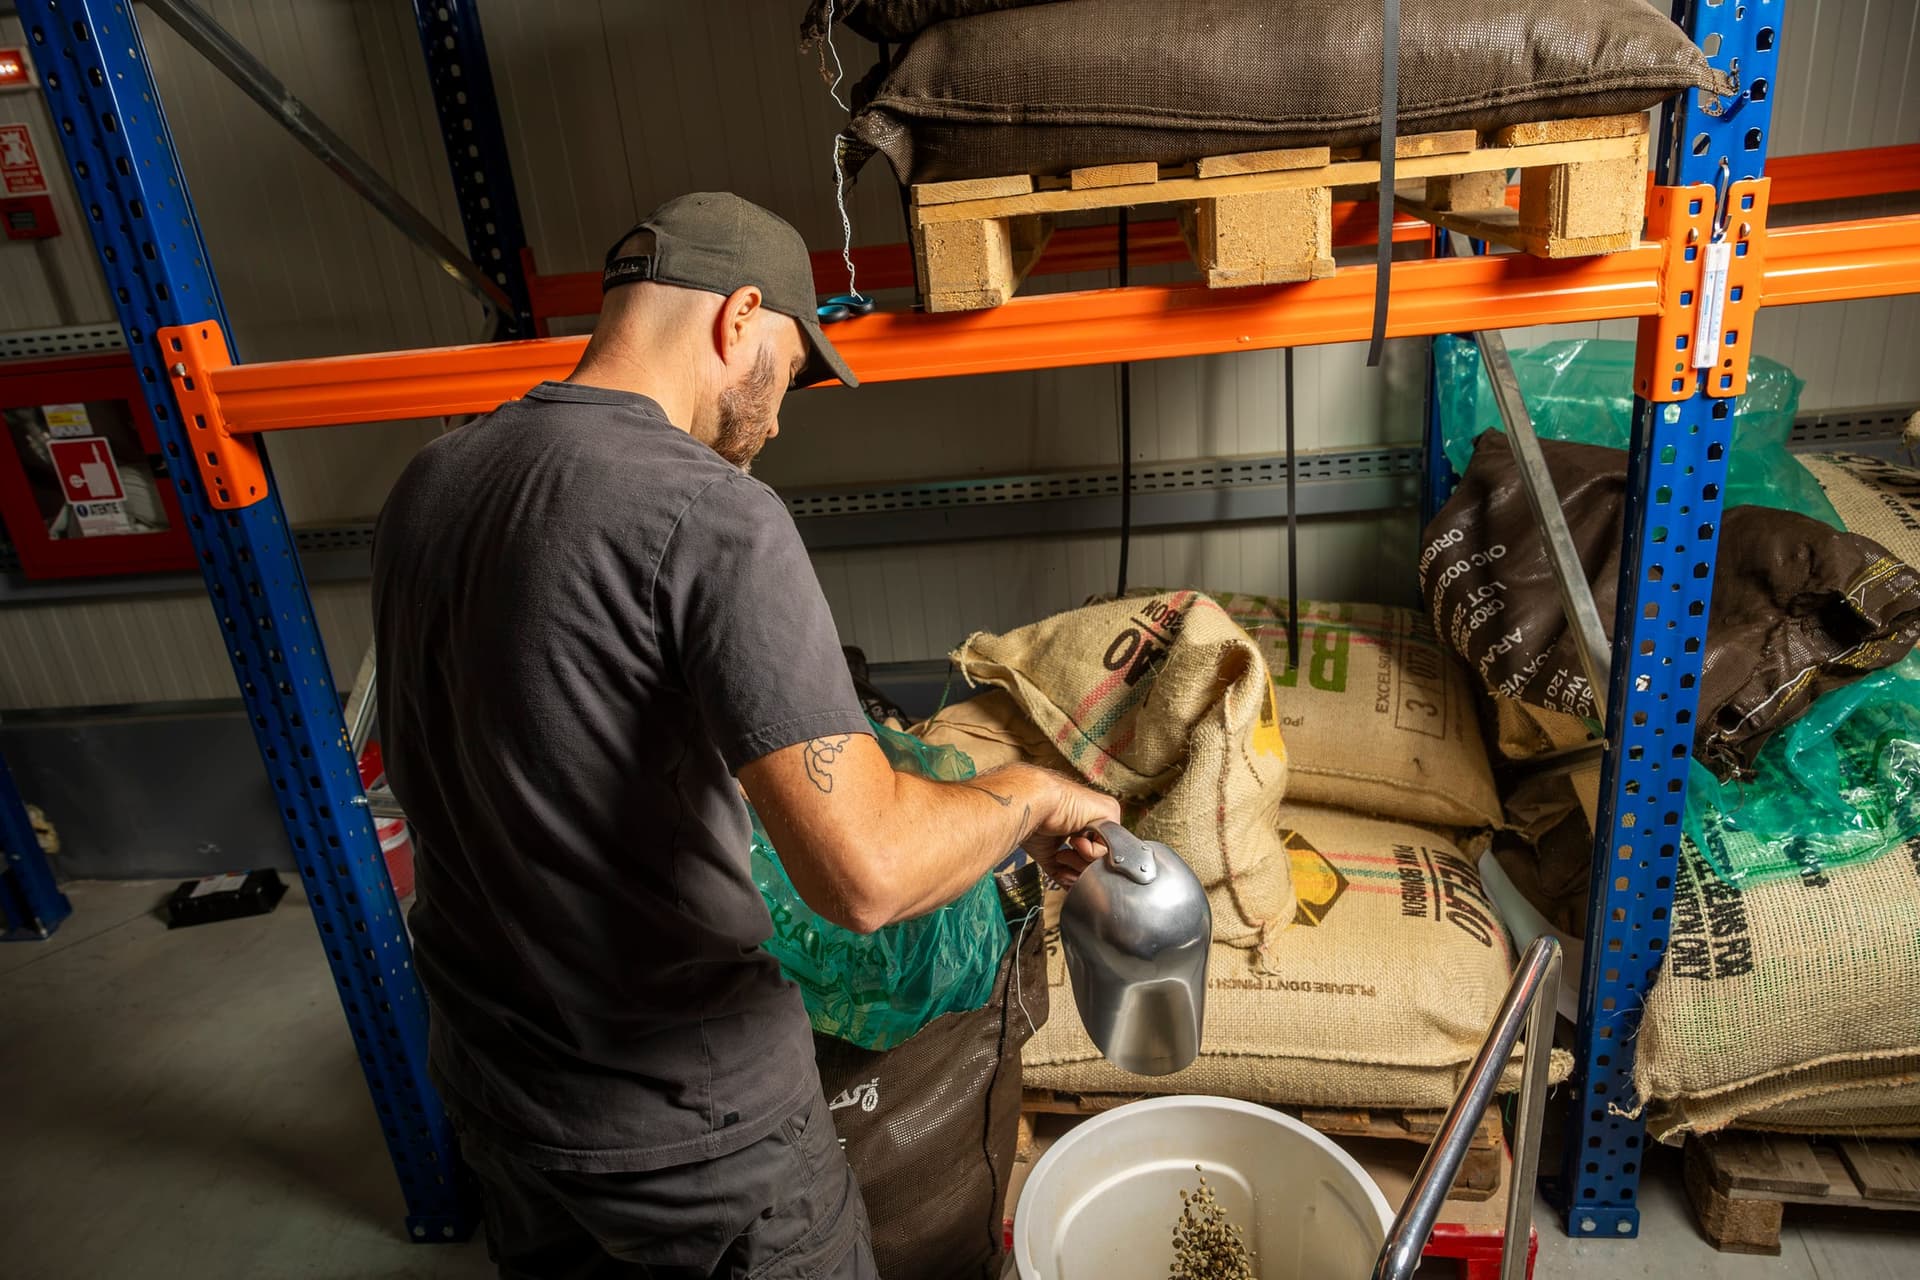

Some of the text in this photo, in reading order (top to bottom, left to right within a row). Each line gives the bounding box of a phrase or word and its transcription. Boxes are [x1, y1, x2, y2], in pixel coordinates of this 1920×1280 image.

[1419, 528, 1465, 573] ORIGIN
[1470, 544, 1508, 568] OIC
[1467, 581, 1509, 608] LOT
[1469, 599, 1505, 630] CROP
[1546, 667, 1568, 697] 120
[1405, 698, 1438, 717] 3
[1391, 844, 1427, 918] PINK BOURBON
[1713, 938, 1754, 980] FOR
